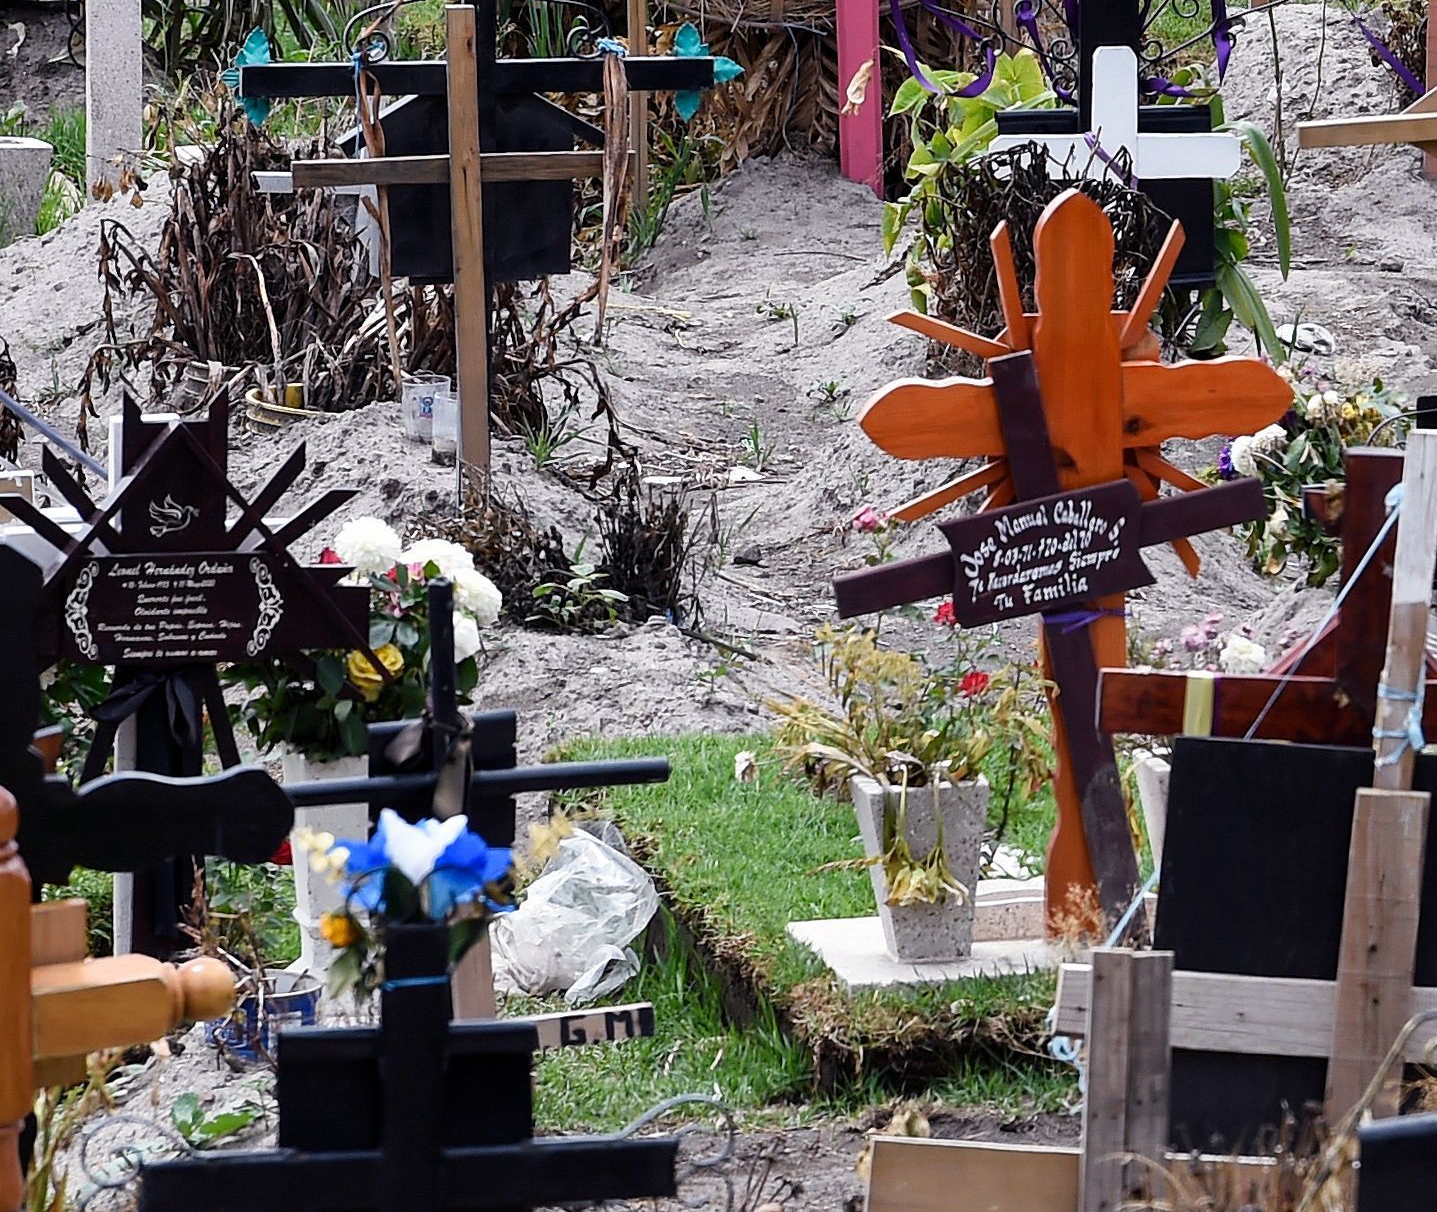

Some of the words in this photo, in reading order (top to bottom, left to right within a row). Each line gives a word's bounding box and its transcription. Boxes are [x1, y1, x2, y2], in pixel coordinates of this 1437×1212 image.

[994, 504, 1049, 543] Manuel
[1053, 499, 1108, 535] Caballero
[993, 593, 1014, 611] Tu
[1022, 572, 1089, 604] Familia
